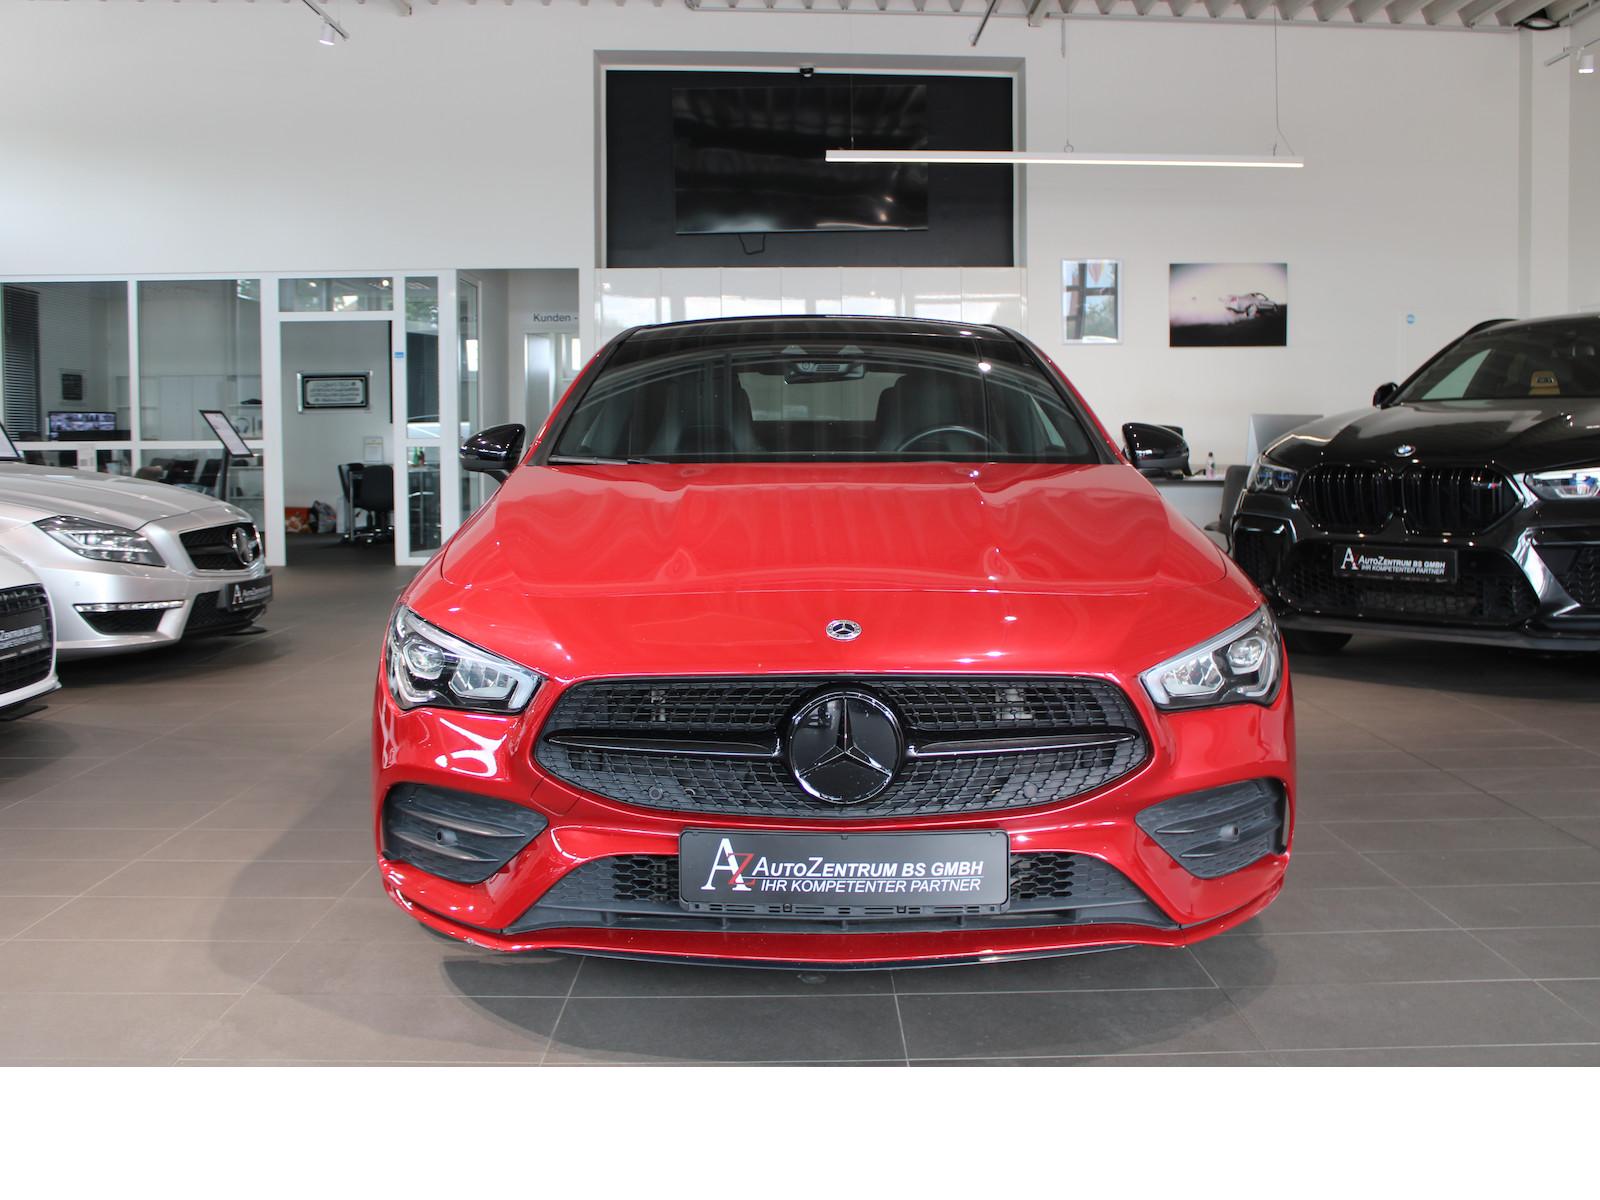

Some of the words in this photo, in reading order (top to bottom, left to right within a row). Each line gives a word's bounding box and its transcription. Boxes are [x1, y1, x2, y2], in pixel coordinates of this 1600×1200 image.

[533, 312, 571, 322] Kunden
[902, 862, 926, 877] BS
[931, 860, 984, 876] GMBH
[761, 879, 787, 892] IHR
[791, 880, 906, 893] KOMPETENTER
[910, 879, 981, 892] PARTNER
